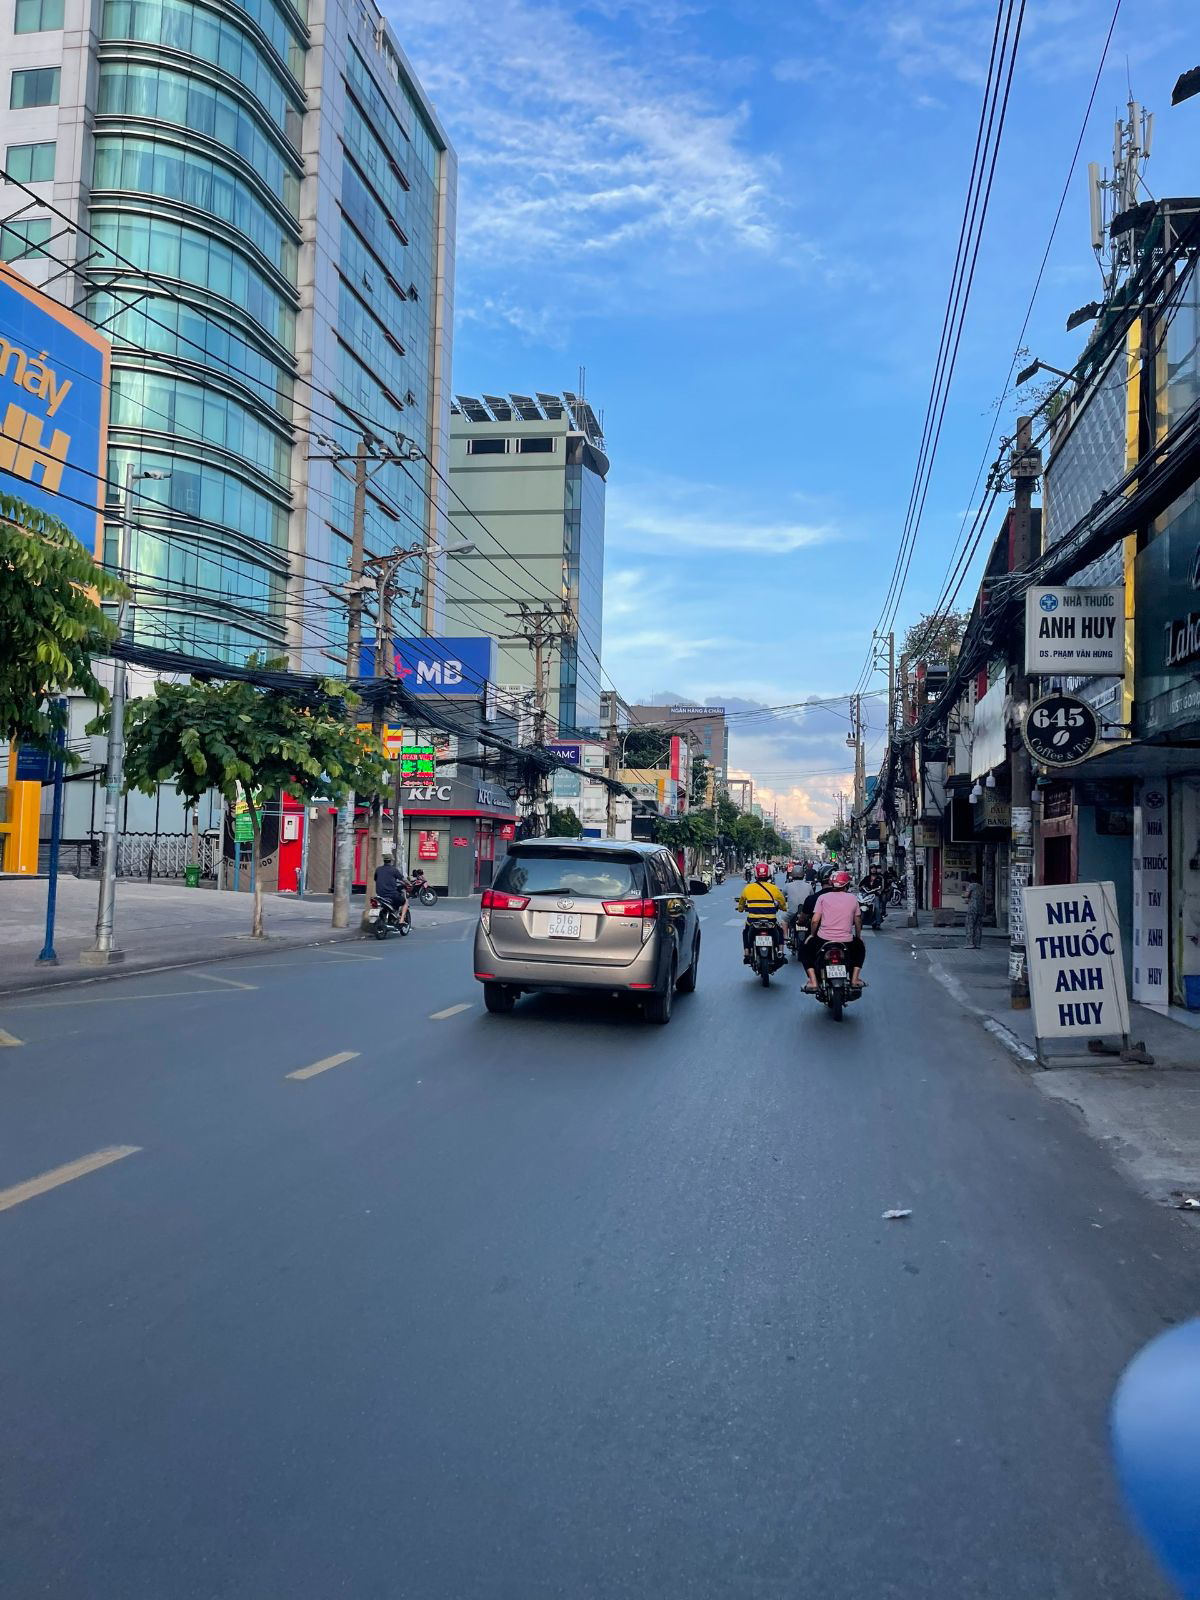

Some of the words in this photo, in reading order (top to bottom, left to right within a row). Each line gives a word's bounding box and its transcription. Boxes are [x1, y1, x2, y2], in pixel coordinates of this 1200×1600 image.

[1063, 594, 1082, 607] NHÀ
[1084, 592, 1114, 607] THUỐC
[1039, 617, 1075, 639] ANH
[1081, 617, 1116, 639] HUY
[1053, 650, 1074, 660] PHẠM
[416, 660, 463, 685] MB
[1032, 708, 1085, 728] 645
[1030, 737, 1064, 761] Coffee
[1073, 736, 1093, 754] Tea
[408, 785, 452, 801] KFC
[478, 788, 492, 805] KFC
[1147, 819, 1163, 836] NHÀ
[1142, 853, 1168, 870] THUỐC
[1148, 889, 1162, 906] TÂY
[1045, 895, 1097, 925] NHÀ
[556, 914, 574, 925] 51G
[1035, 926, 1116, 960] THUỐC
[1147, 928, 1163, 947] ANH
[1055, 967, 1104, 993] ANH
[1147, 967, 1163, 985] HUY
[1058, 1001, 1104, 1027] HUY
